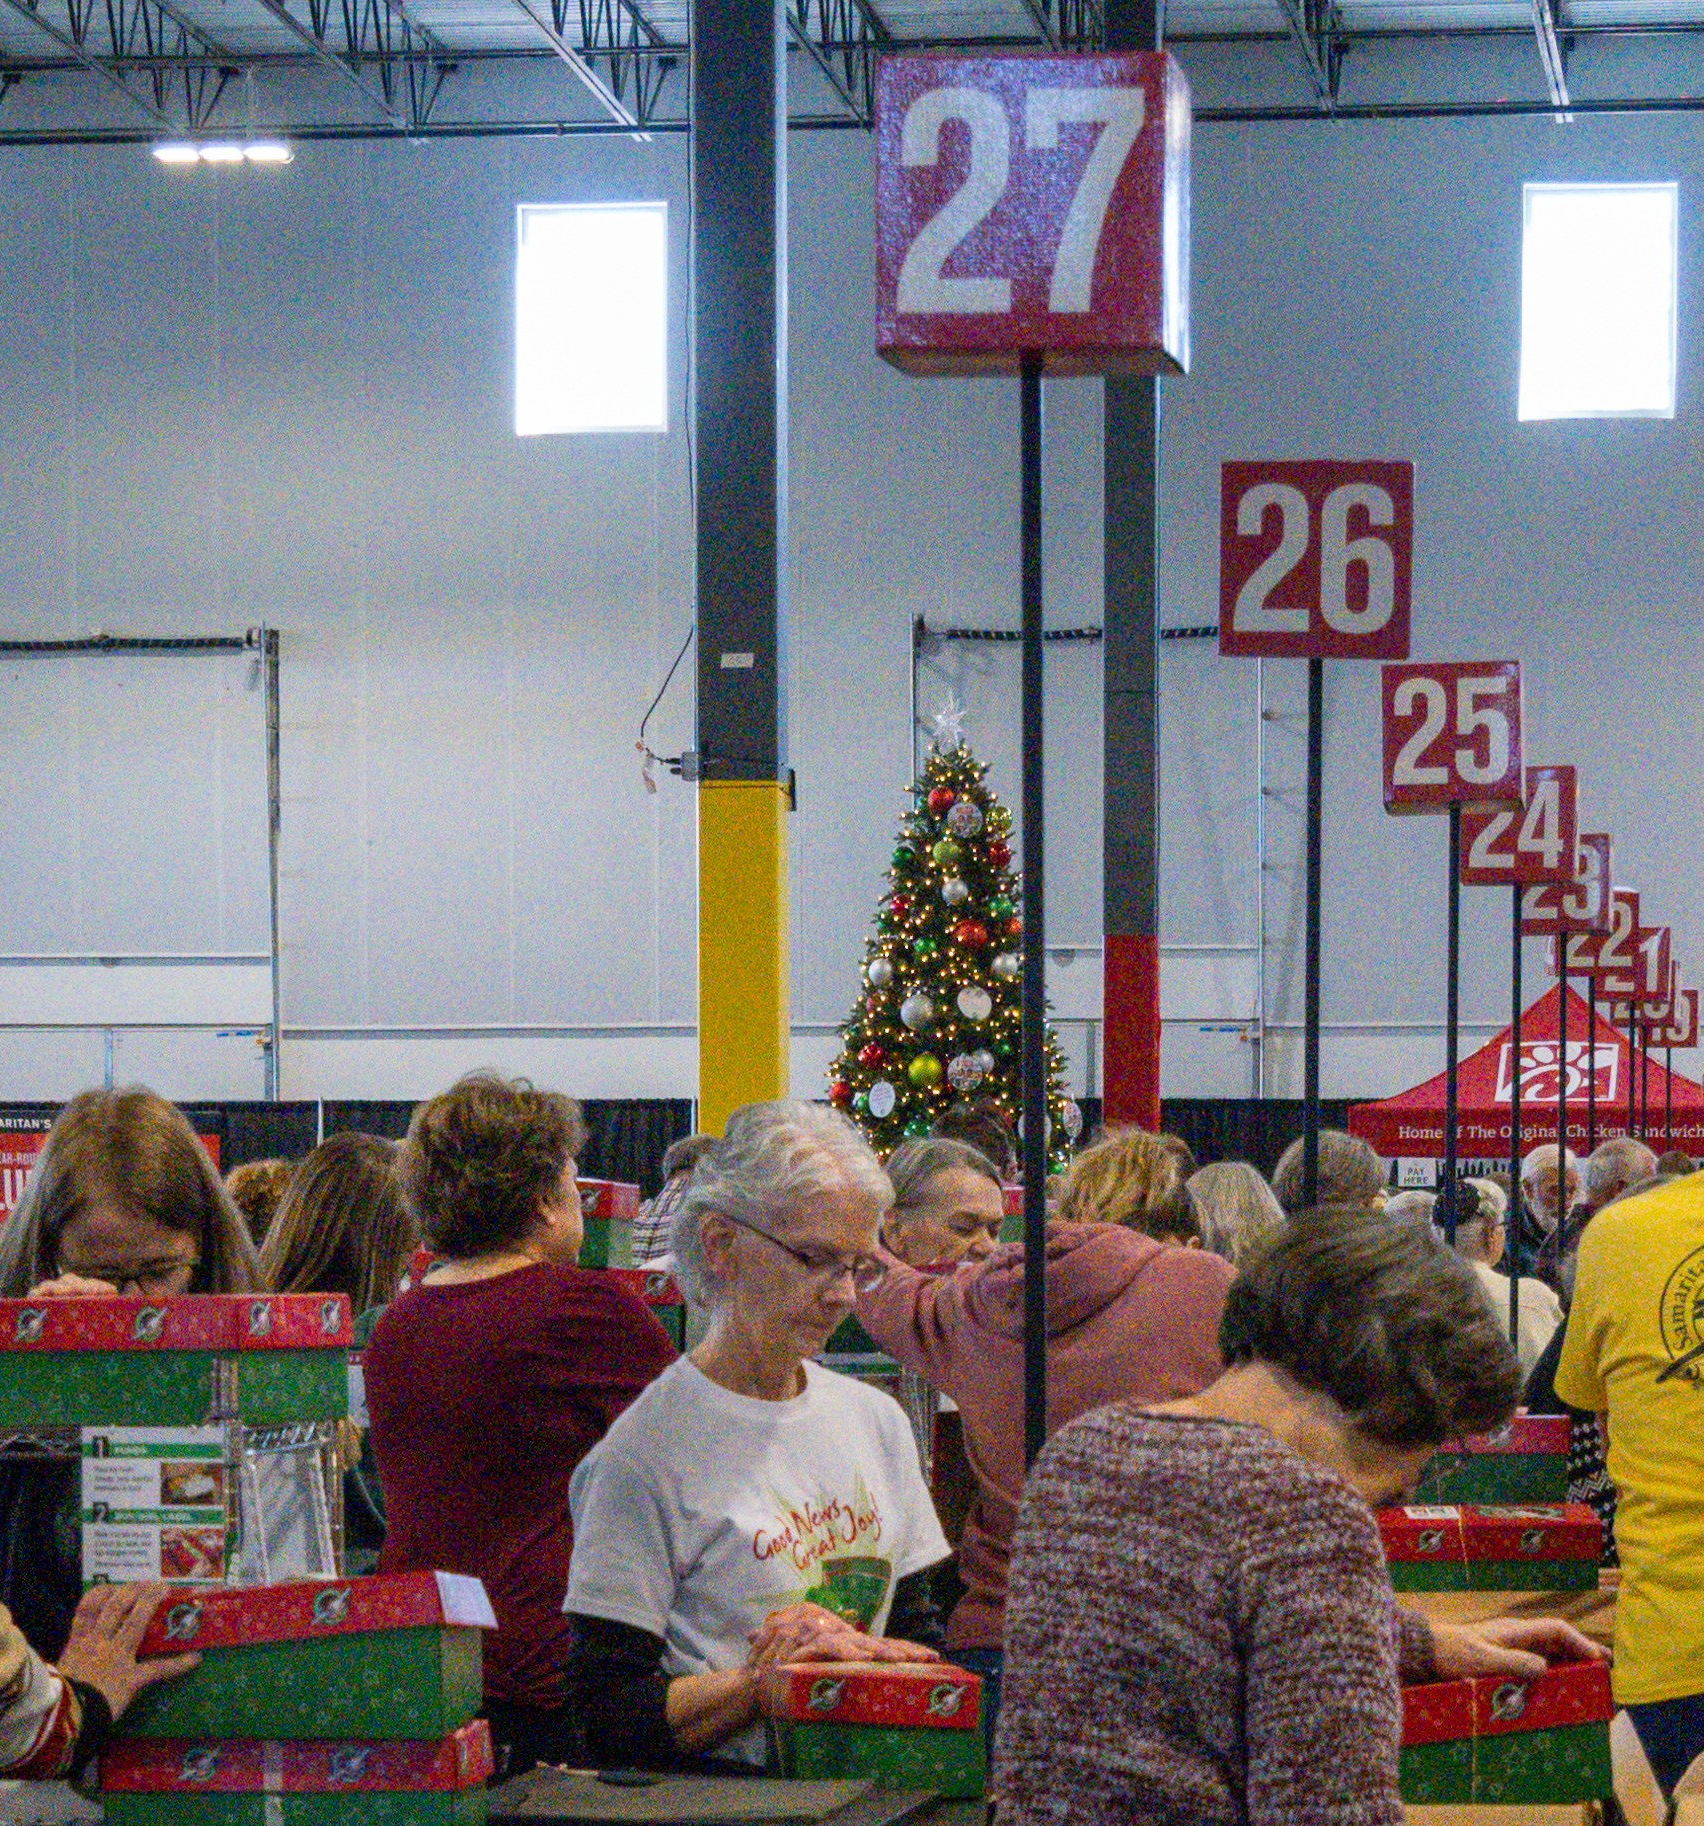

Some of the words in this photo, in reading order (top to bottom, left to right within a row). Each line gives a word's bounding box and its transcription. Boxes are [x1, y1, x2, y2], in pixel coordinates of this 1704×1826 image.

[896, 86, 1145, 313] 27
[1233, 482, 1396, 634] 26
[1392, 676, 1510, 786] 25
[1468, 779, 1565, 869] 24
[1604, 929, 1662, 992] 1
[1398, 1125, 1444, 1139] Home
[1468, 1125, 1496, 1139] The
[1499, 1124, 1560, 1142] Oigina
[1565, 1124, 1627, 1139] Chcken
[1408, 1166, 1425, 1175] PAY
[752, 1517, 793, 1561] Good
[792, 1527, 838, 1572] Great
